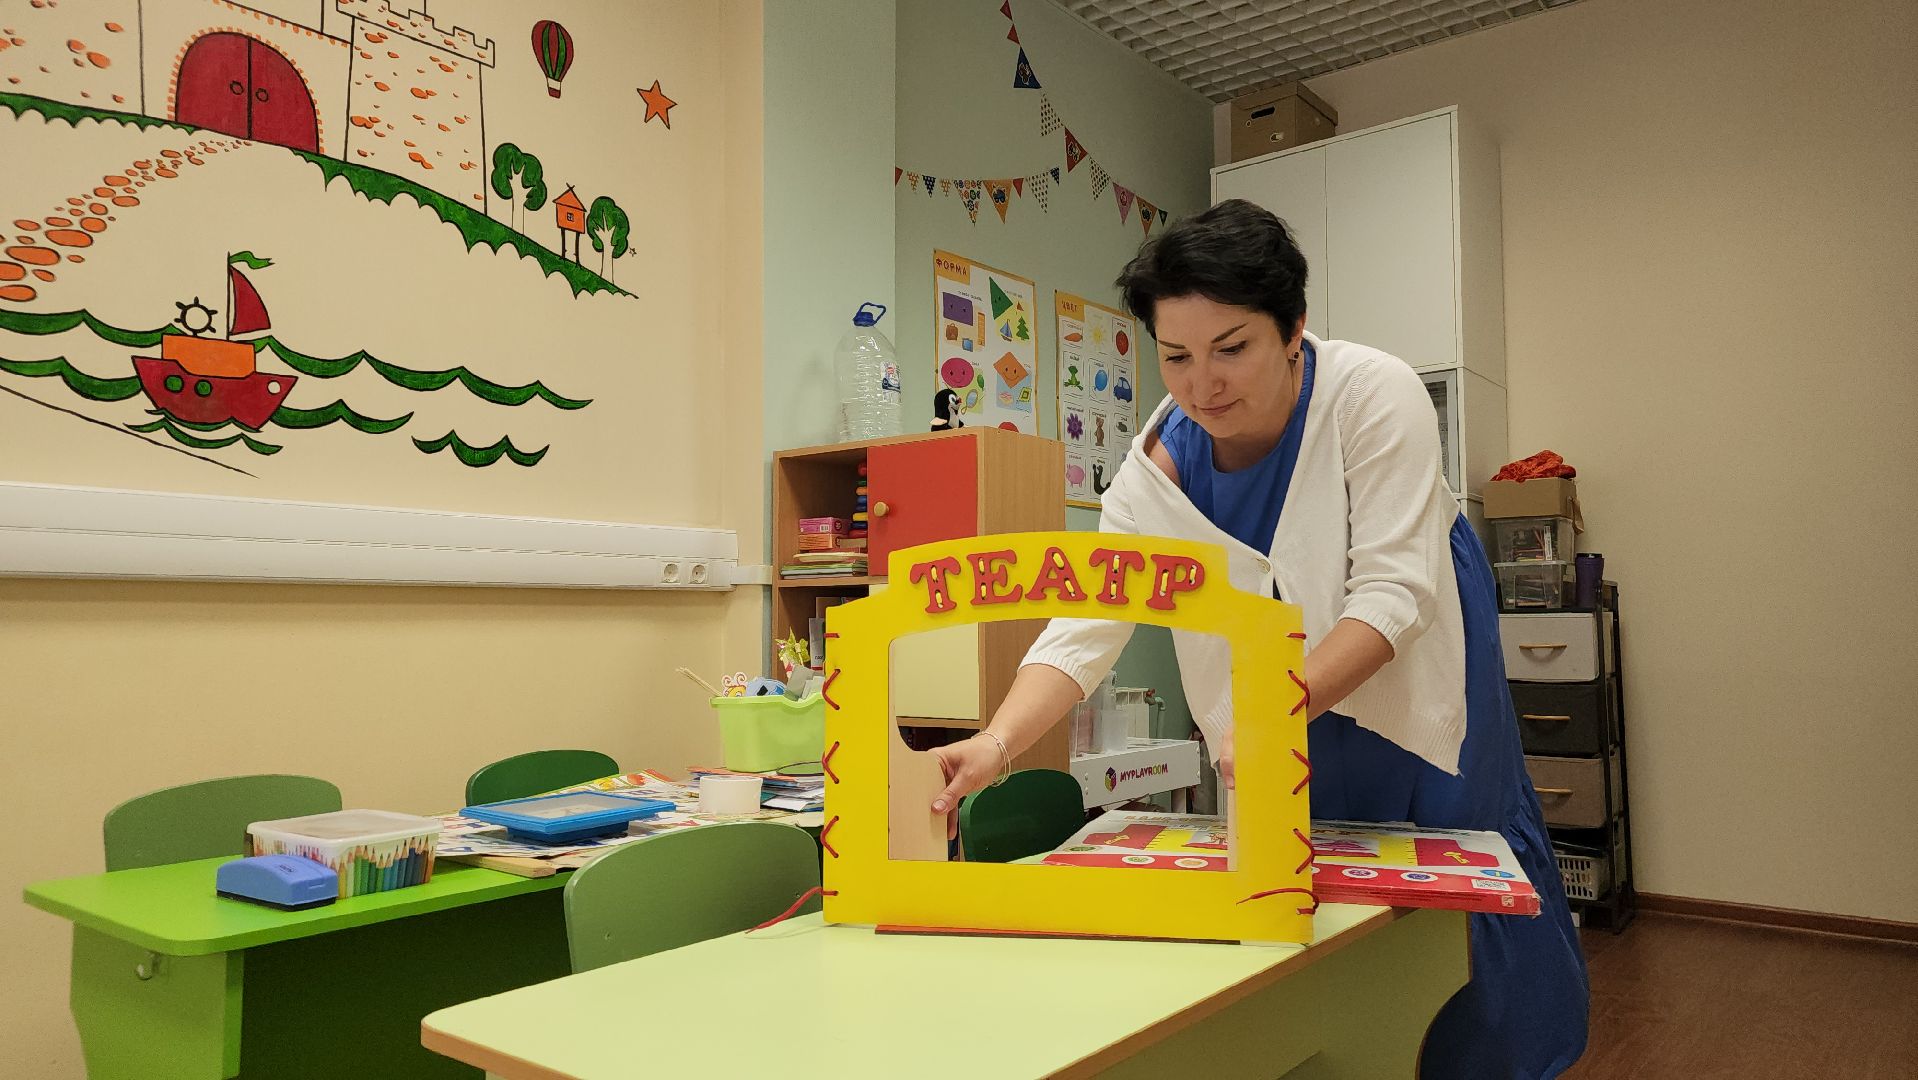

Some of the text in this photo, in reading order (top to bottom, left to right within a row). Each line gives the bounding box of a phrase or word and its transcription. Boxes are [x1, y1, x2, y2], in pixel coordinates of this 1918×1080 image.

[935, 258, 967, 276] ФОРМА
[910, 546, 1205, 614] ТЕАТР
[1119, 763, 1168, 782] MYPLAYROOM
